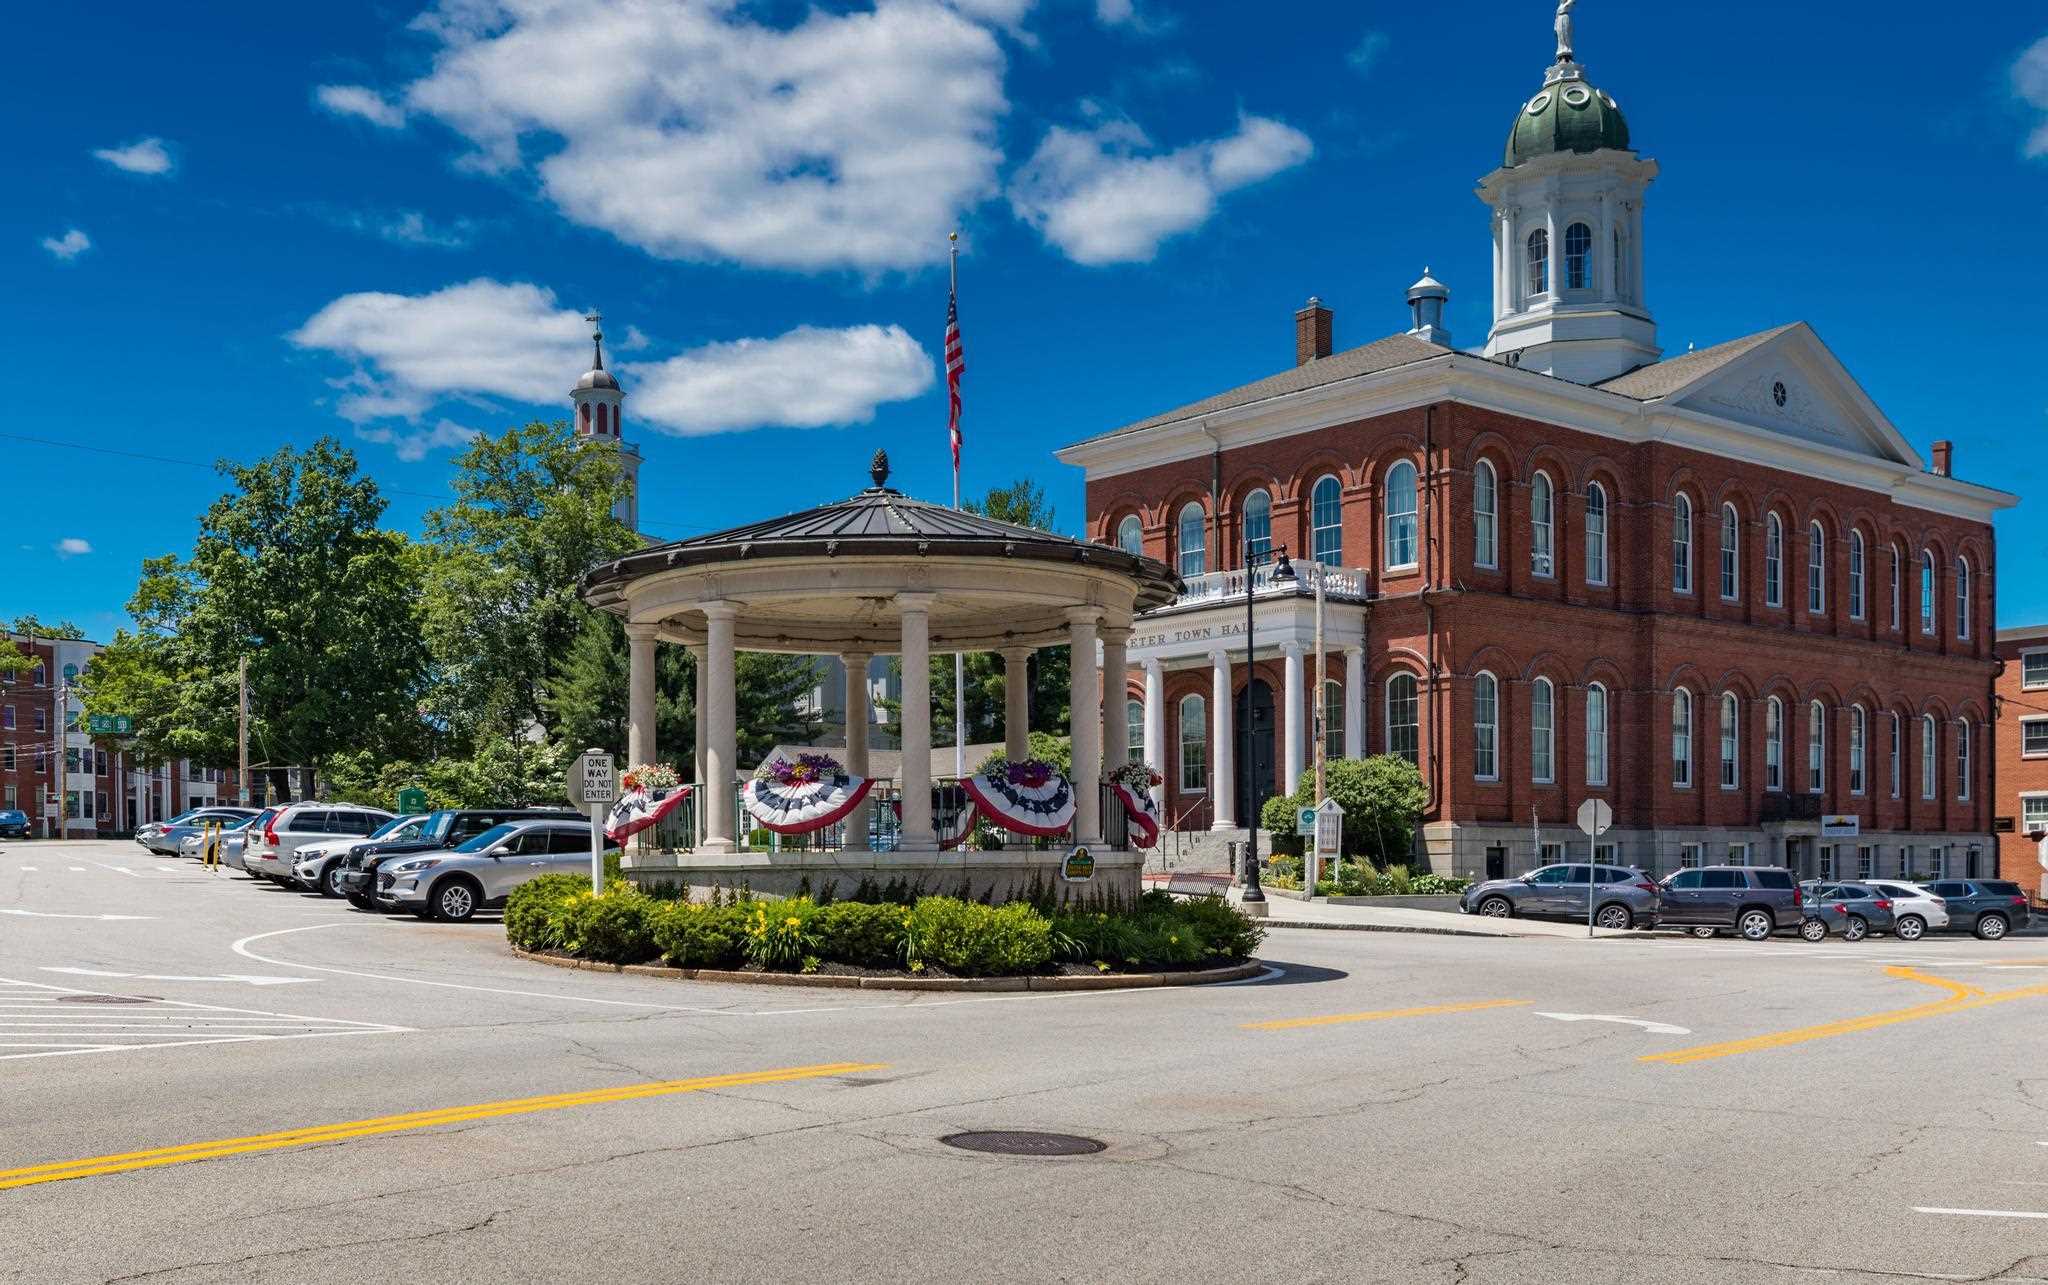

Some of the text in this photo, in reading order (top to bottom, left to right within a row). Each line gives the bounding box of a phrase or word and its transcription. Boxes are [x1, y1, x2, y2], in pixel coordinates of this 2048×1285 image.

[1130, 634, 1166, 648] ETER
[1175, 627, 1211, 641] TOWN
[588, 759, 607, 767] ONE
[587, 769, 608, 777] WAY
[584, 780, 612, 788] DO NOT
[585, 790, 611, 799] ENTER
